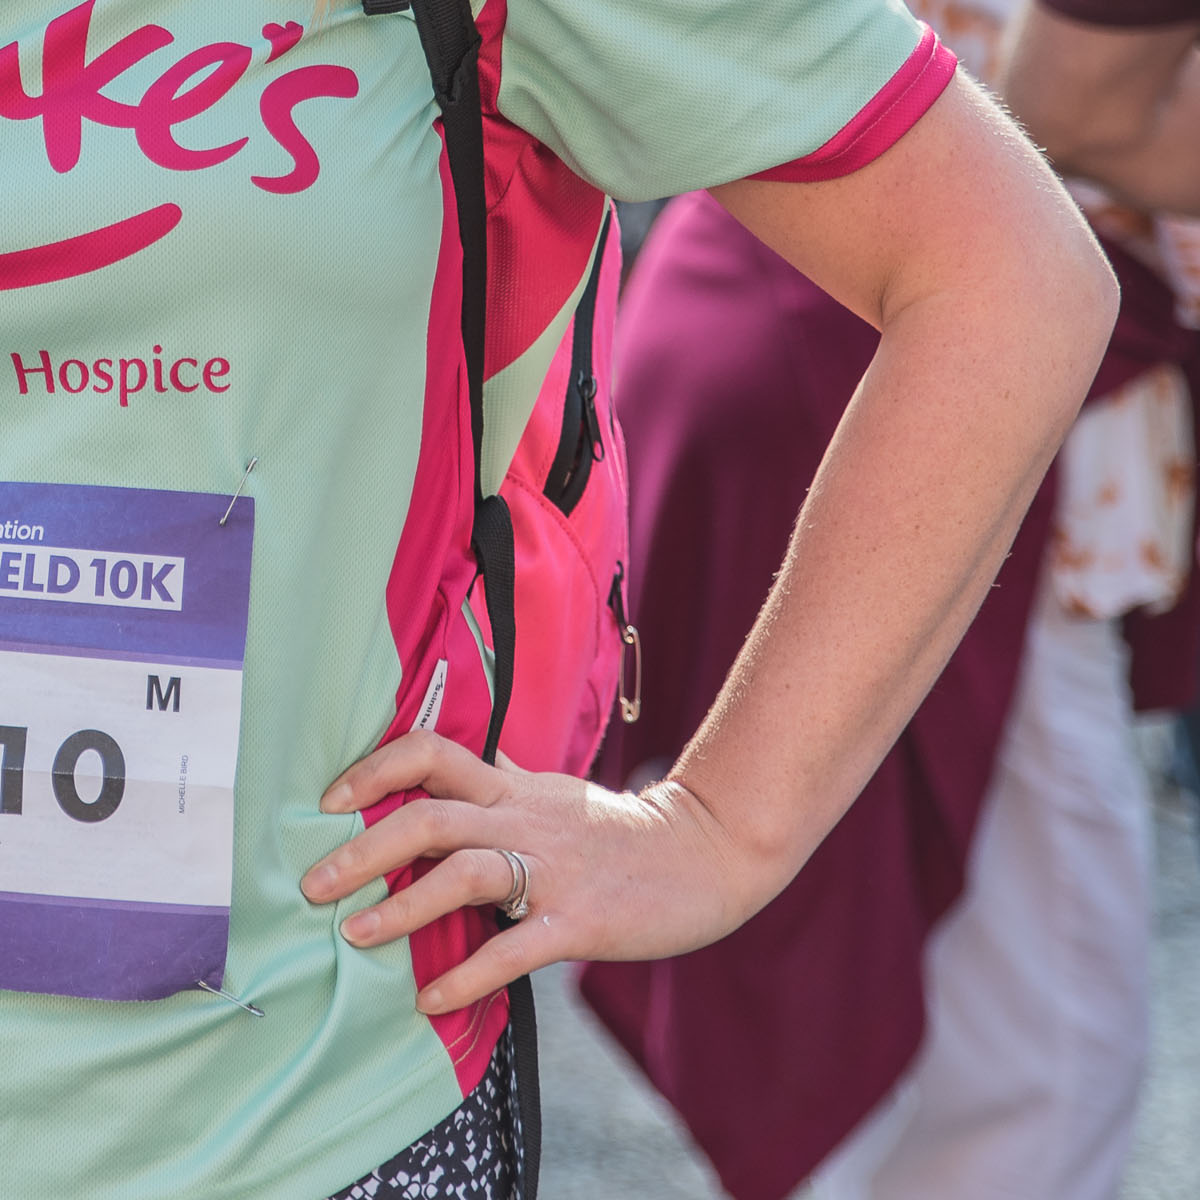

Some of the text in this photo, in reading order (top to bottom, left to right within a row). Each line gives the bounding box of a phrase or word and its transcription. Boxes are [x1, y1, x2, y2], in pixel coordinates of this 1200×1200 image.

[10, 344, 232, 408] Hospice
[89, 558, 177, 603] 10K
[146, 674, 182, 713] M
[178, 754, 189, 814] MICHELLE BIRD
